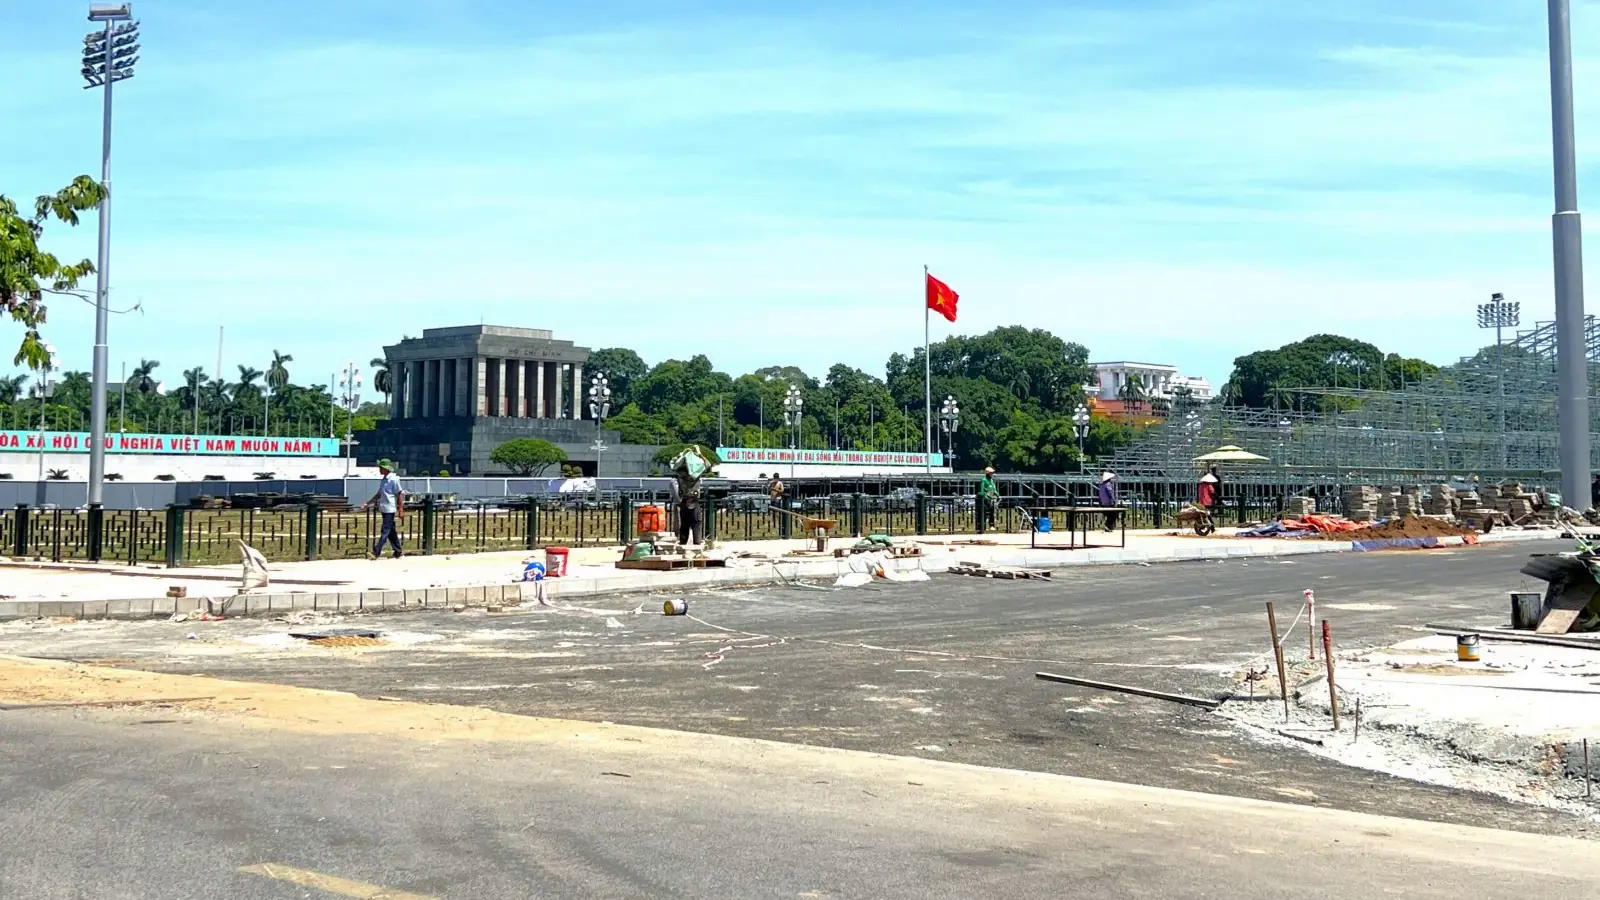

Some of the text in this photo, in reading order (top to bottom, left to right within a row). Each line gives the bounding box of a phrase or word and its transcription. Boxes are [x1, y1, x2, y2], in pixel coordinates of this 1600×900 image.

[53, 434, 78, 451] HỘI
[85, 434, 114, 449] CỦ
[121, 436, 163, 450] NGHĨA
[171, 437, 200, 452] VIỆT
[206, 439, 235, 451] NAM
[241, 438, 279, 452] MUÔN
[284, 439, 312, 453] NĂM
